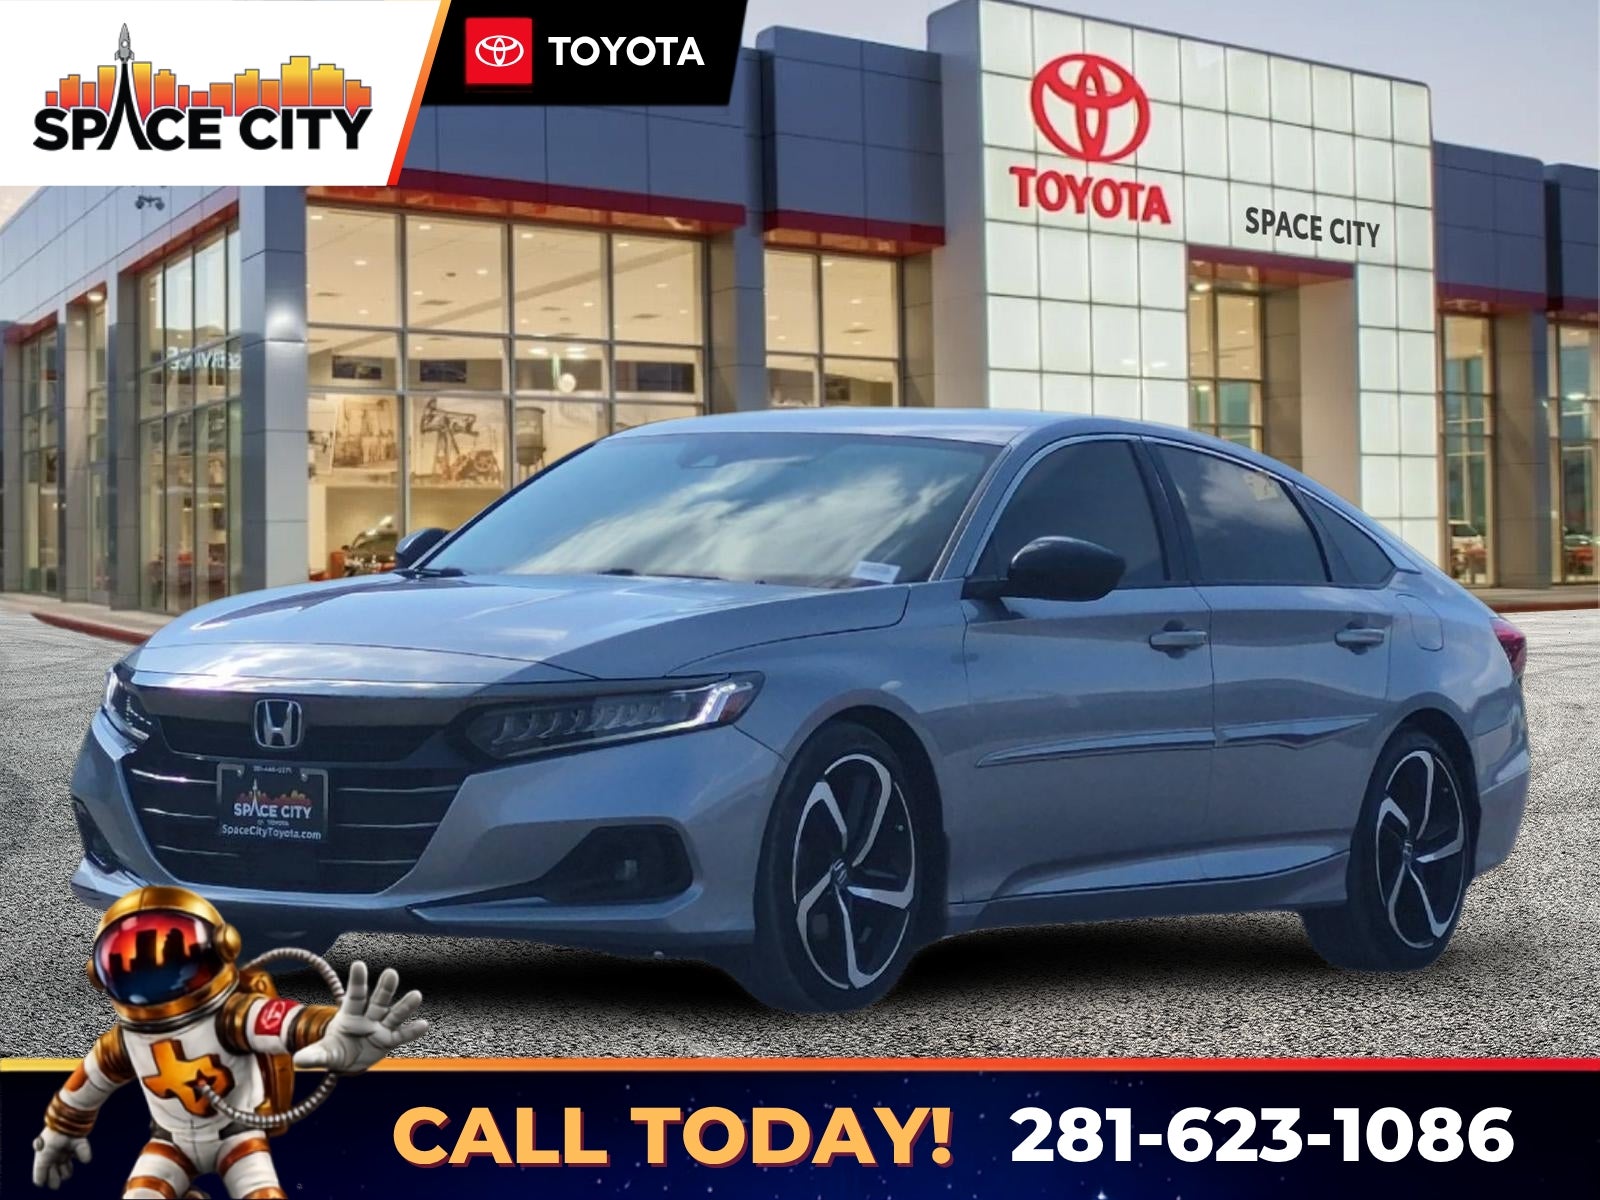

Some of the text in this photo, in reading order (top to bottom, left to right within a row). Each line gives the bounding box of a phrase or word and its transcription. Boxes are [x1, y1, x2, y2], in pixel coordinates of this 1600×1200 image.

[1009, 166, 1172, 225] TOYOTA
[1245, 206, 1381, 249] SPACE CITY
[233, 802, 312, 819] SPACE CITY
[221, 823, 322, 841] SpaceCityToyota.com
